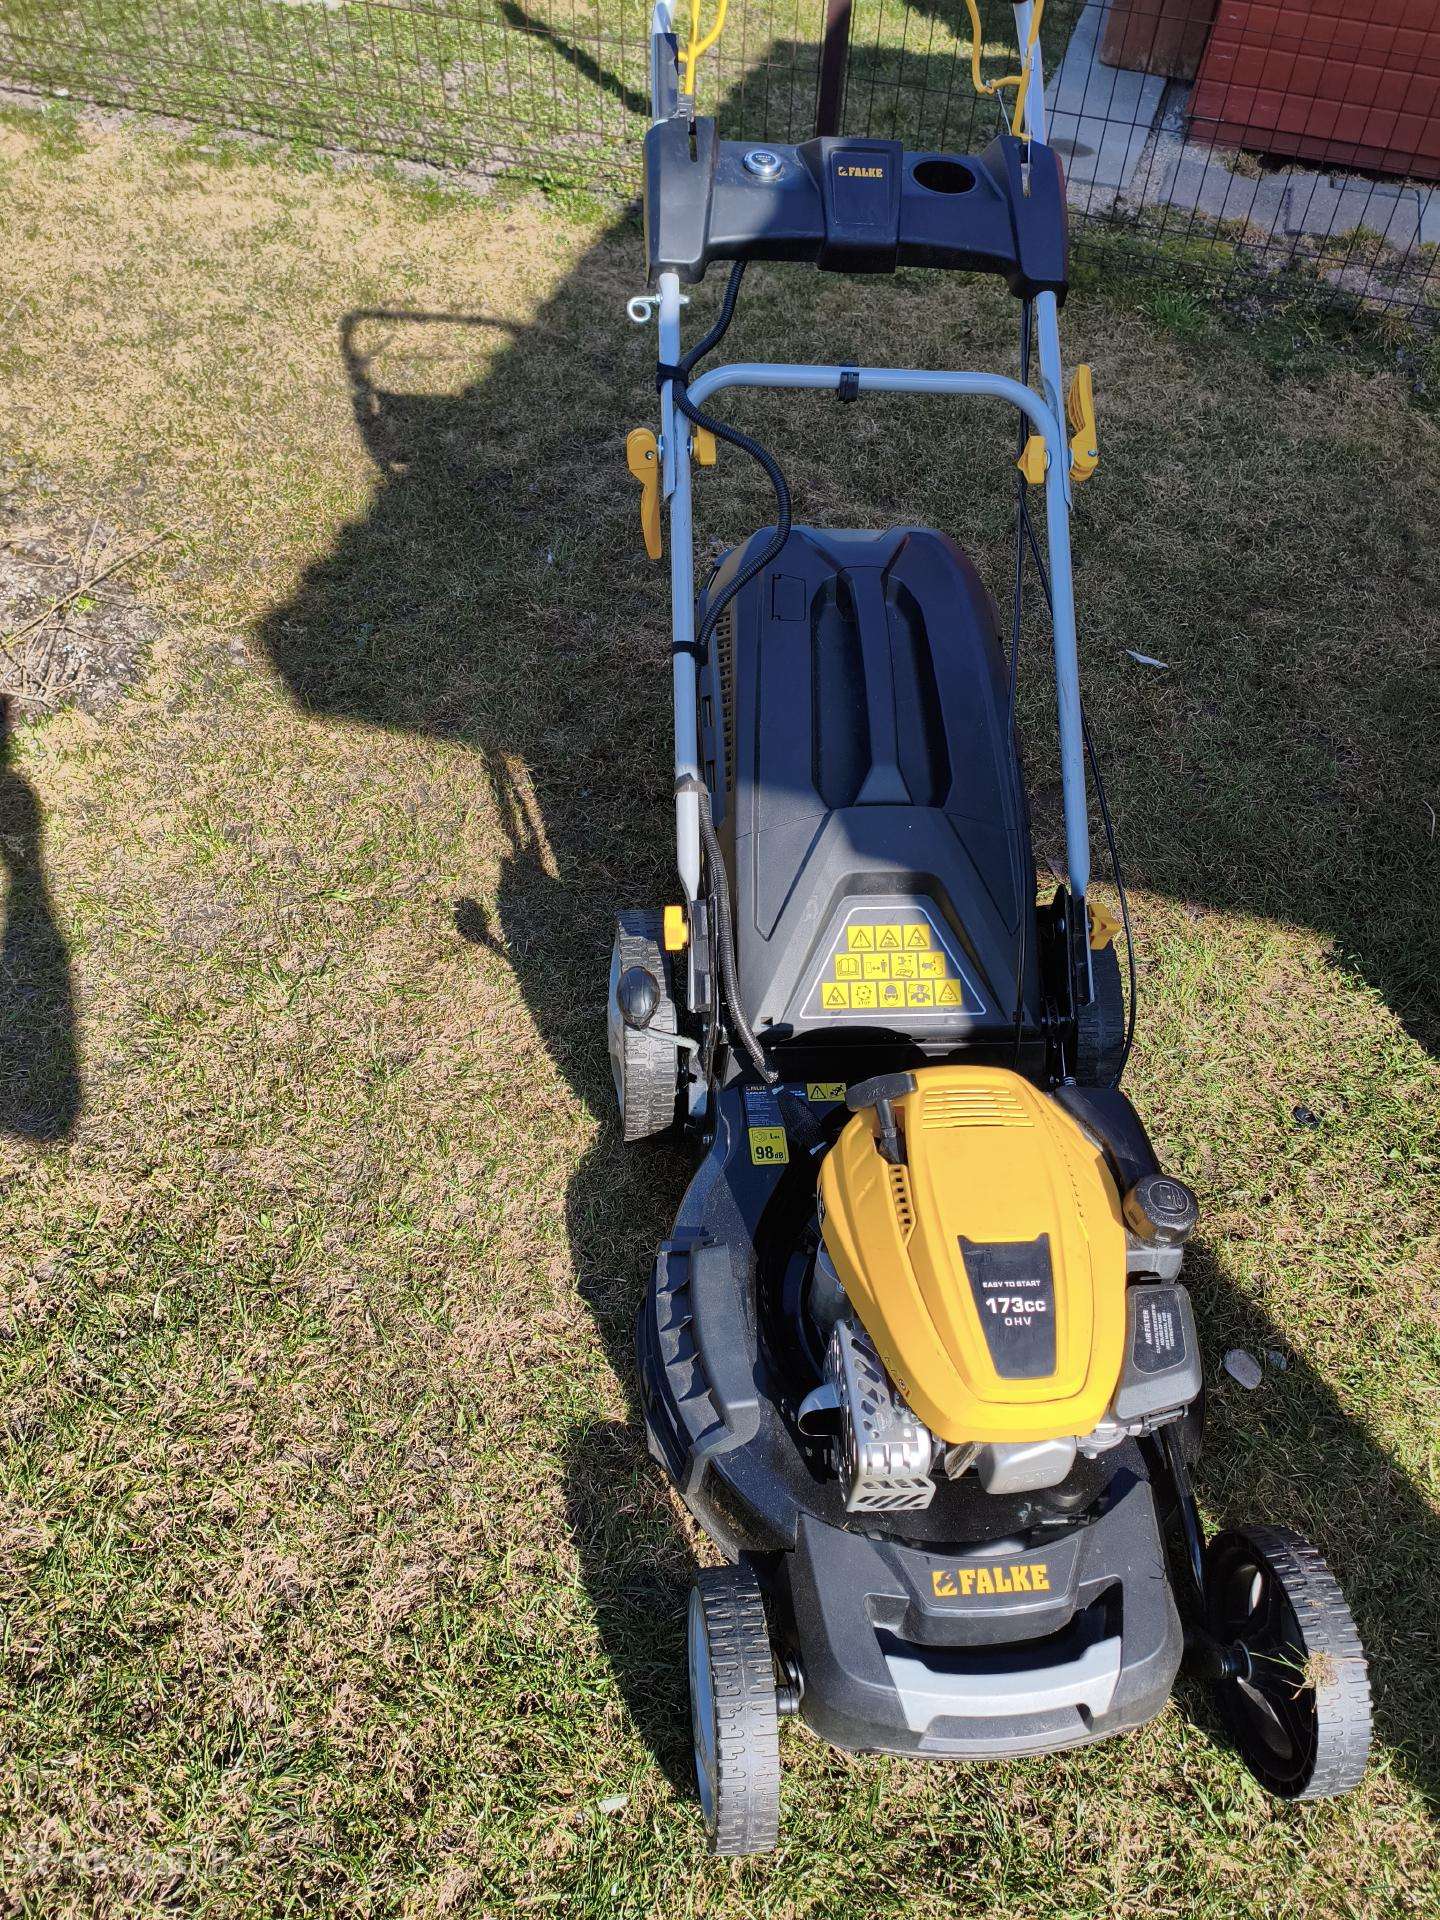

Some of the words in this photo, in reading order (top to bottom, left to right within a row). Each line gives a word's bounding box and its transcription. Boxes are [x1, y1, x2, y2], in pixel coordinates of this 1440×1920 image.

[848, 166, 883, 178] FALKE
[1016, 1280, 1041, 1288] START
[985, 1297, 1046, 1314] 173cc
[1143, 1309, 1151, 1332] FILTER
[959, 1564, 1049, 1595] FALKE
